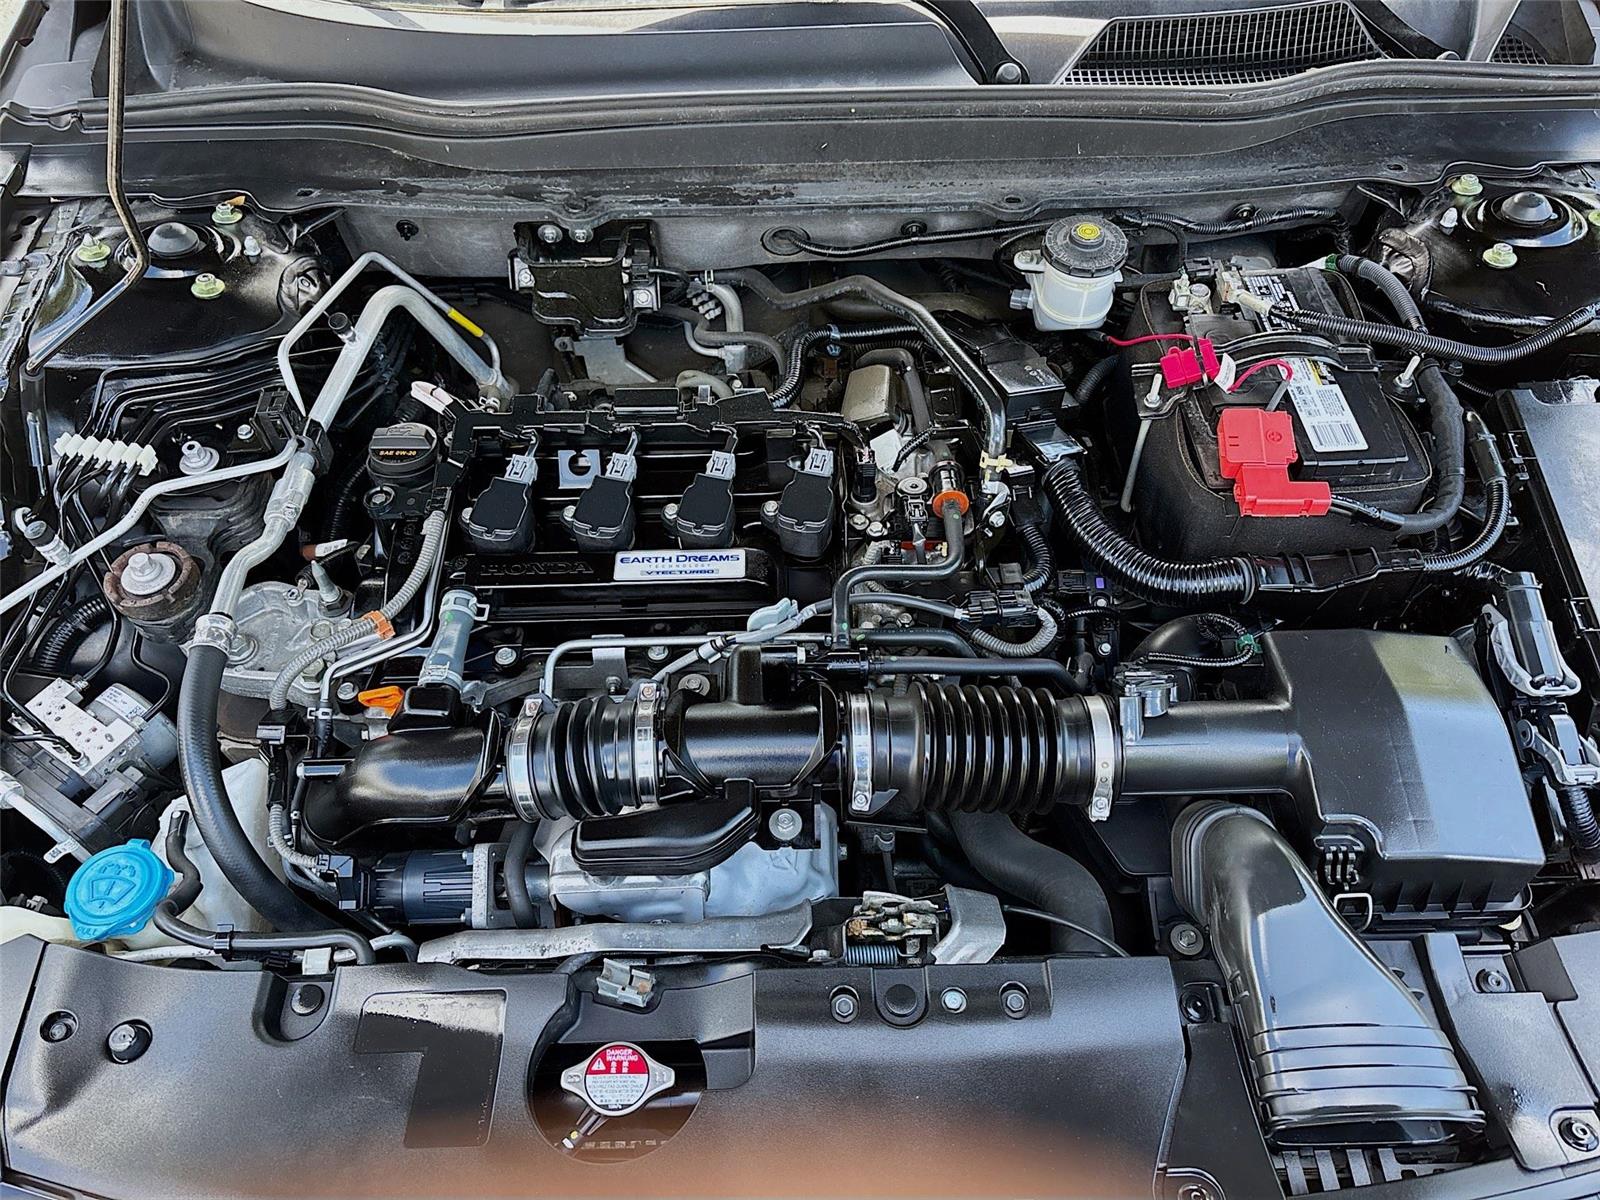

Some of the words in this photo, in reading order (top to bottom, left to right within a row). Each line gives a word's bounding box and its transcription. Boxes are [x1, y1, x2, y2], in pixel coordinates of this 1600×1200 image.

[619, 556, 673, 564] EARTH
[676, 555, 740, 563] DREAMS
[480, 561, 594, 576] HONDA
[76, 925, 98, 936] PULL
